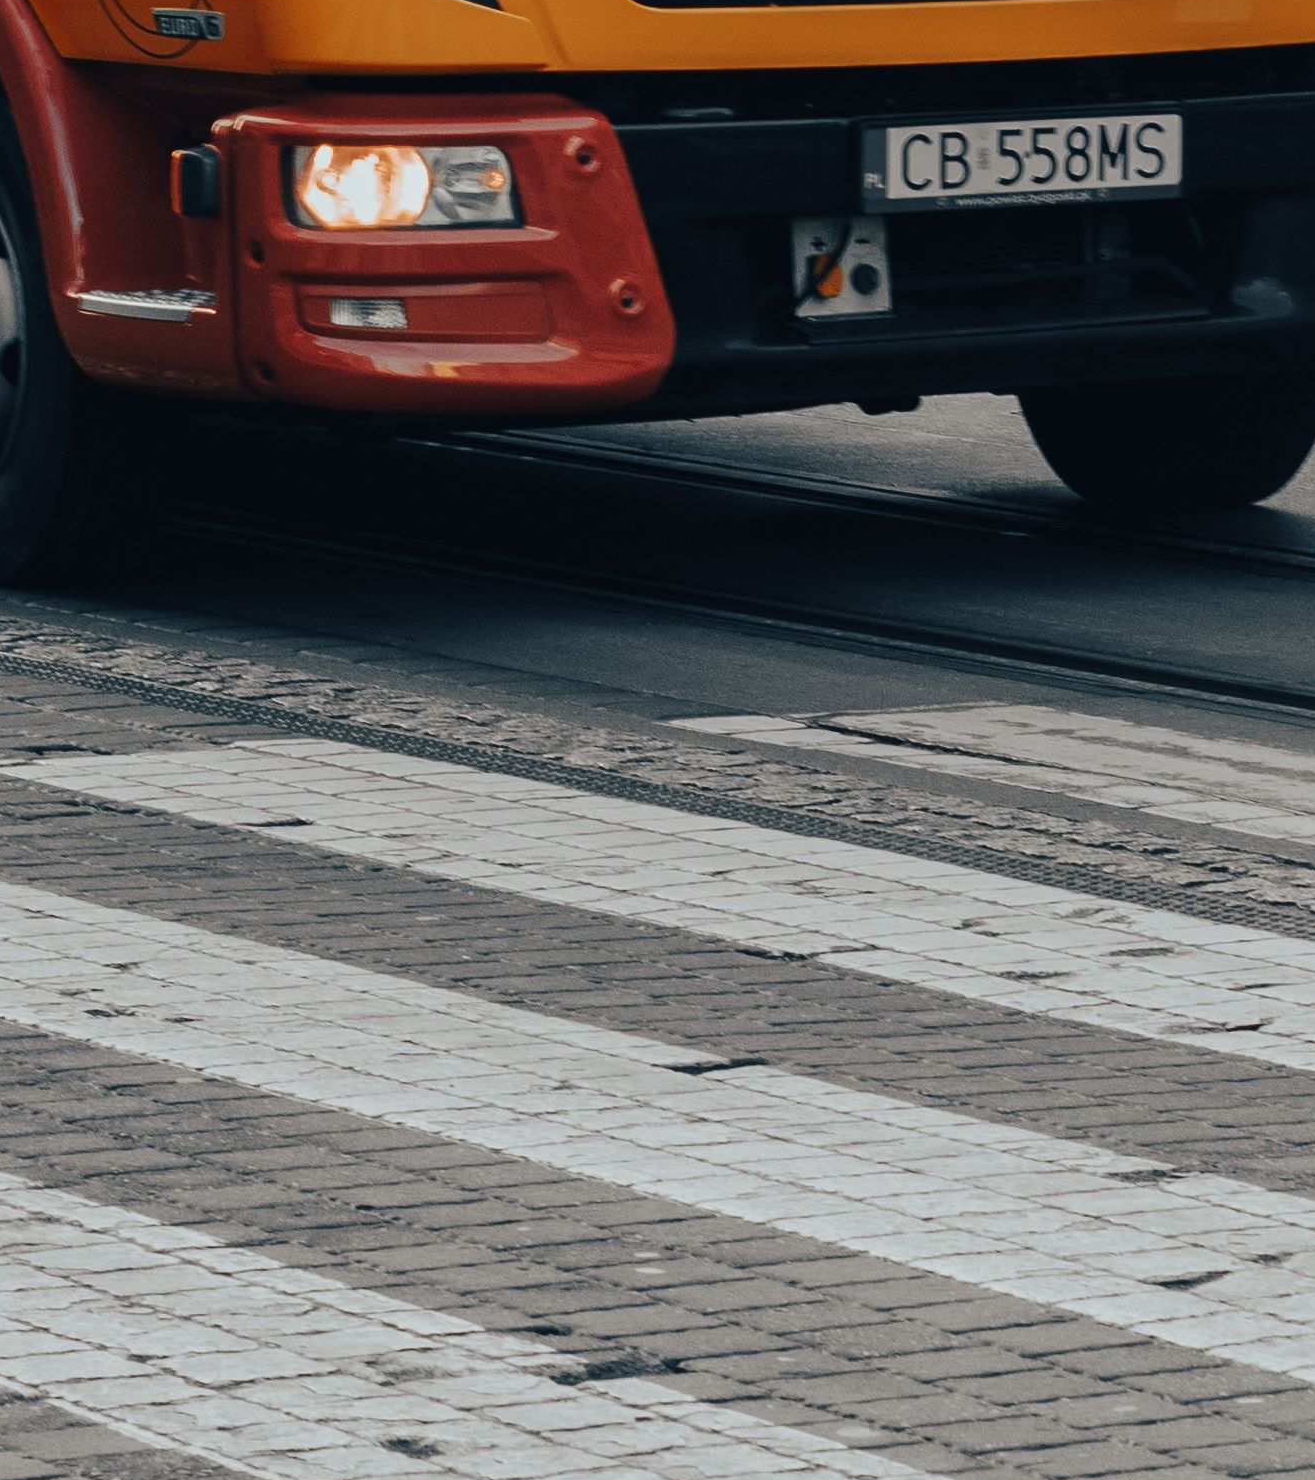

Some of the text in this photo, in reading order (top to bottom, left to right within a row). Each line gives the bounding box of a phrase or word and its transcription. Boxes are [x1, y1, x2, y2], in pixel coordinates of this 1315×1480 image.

[902, 122, 1166, 191] CB 558MS
[864, 173, 886, 189] PL
